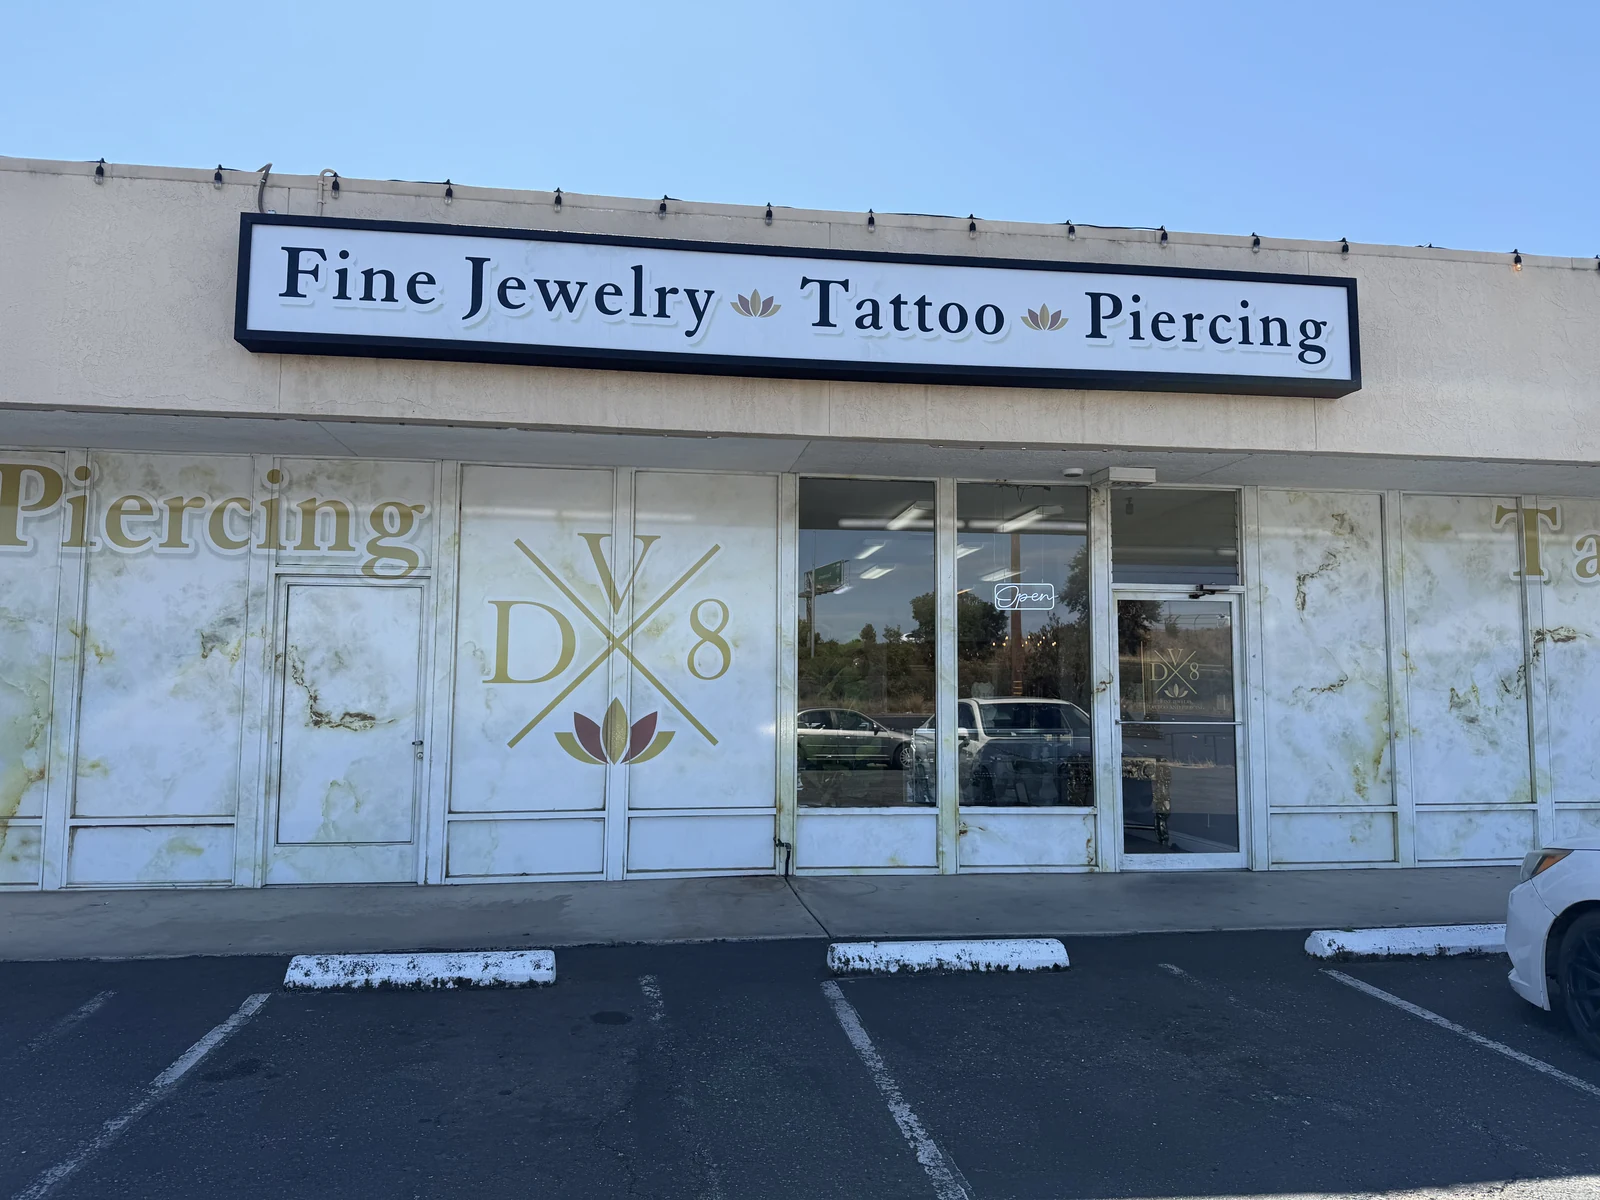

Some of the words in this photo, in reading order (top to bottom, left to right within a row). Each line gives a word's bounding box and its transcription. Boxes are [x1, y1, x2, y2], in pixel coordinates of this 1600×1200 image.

[278, 246, 436, 305] Fine
[461, 256, 716, 338] Jewelry
[799, 276, 1005, 336] Tattoo
[1084, 291, 1328, 365] Piercing
[0, 463, 426, 579] Piercing
[577, 532, 661, 615] V
[995, 585, 1059, 610] Open
[481, 600, 577, 684] D
[687, 598, 732, 681] 8
